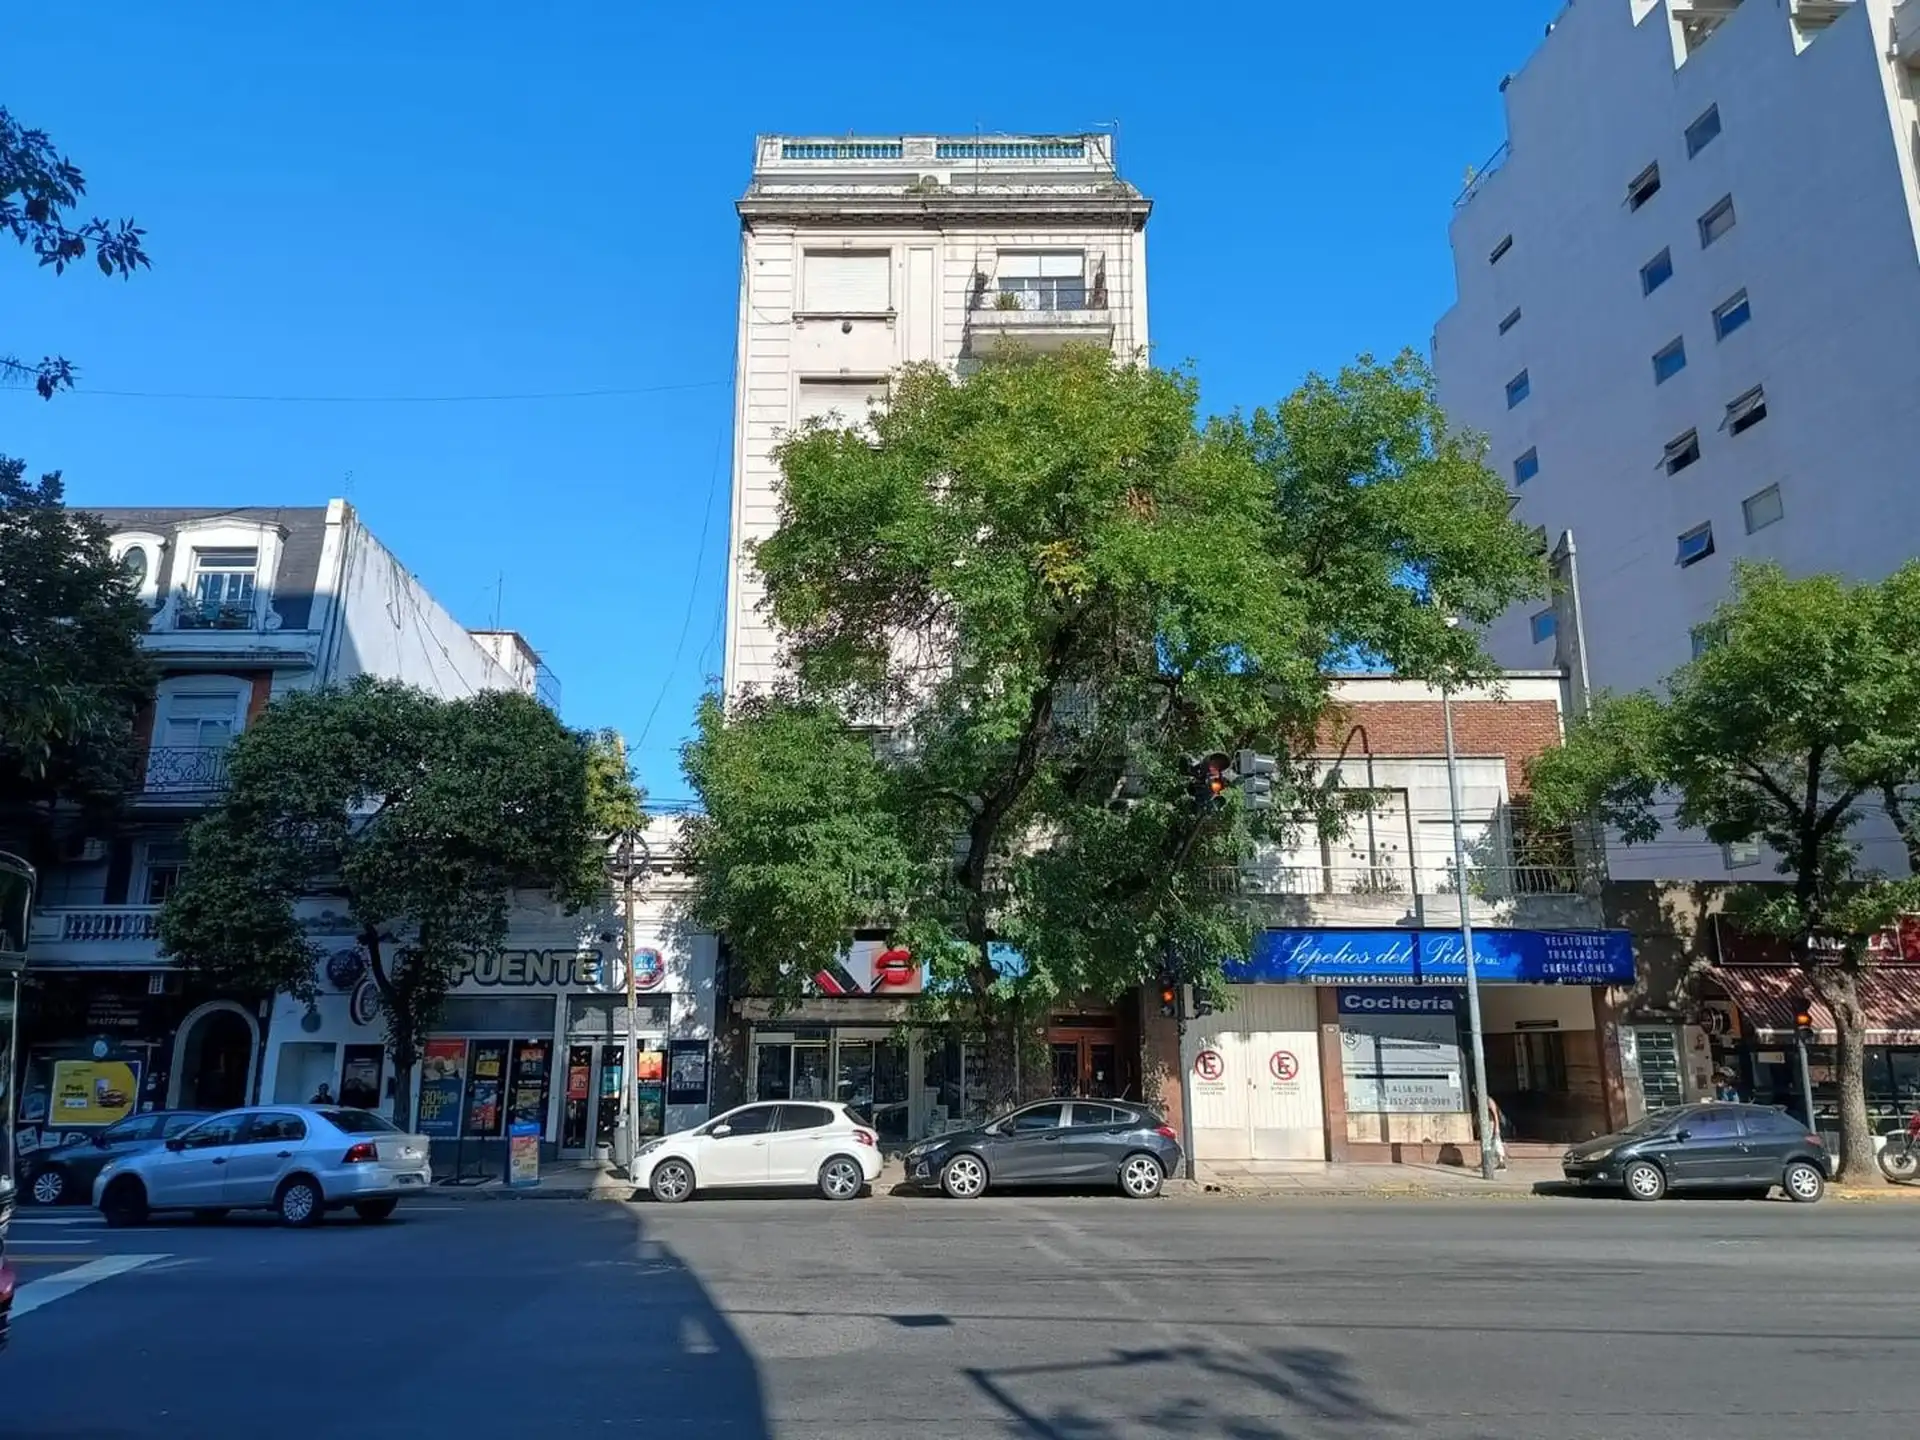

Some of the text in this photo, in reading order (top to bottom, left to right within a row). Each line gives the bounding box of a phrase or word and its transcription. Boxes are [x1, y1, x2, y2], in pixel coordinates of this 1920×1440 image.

[1544, 935, 1606, 946] VELATORIOS
[1282, 935, 1370, 975] Sepelios
[1375, 940, 1417, 965] del
[1548, 949, 1606, 960] TRASLADOS
[449, 950, 602, 986] PUENTE
[1542, 962, 1615, 973] CREMACIONES
[1311, 974, 1354, 984] Empresa
[1356, 975, 1369, 983] de
[1344, 994, 1454, 1010] Cochería
